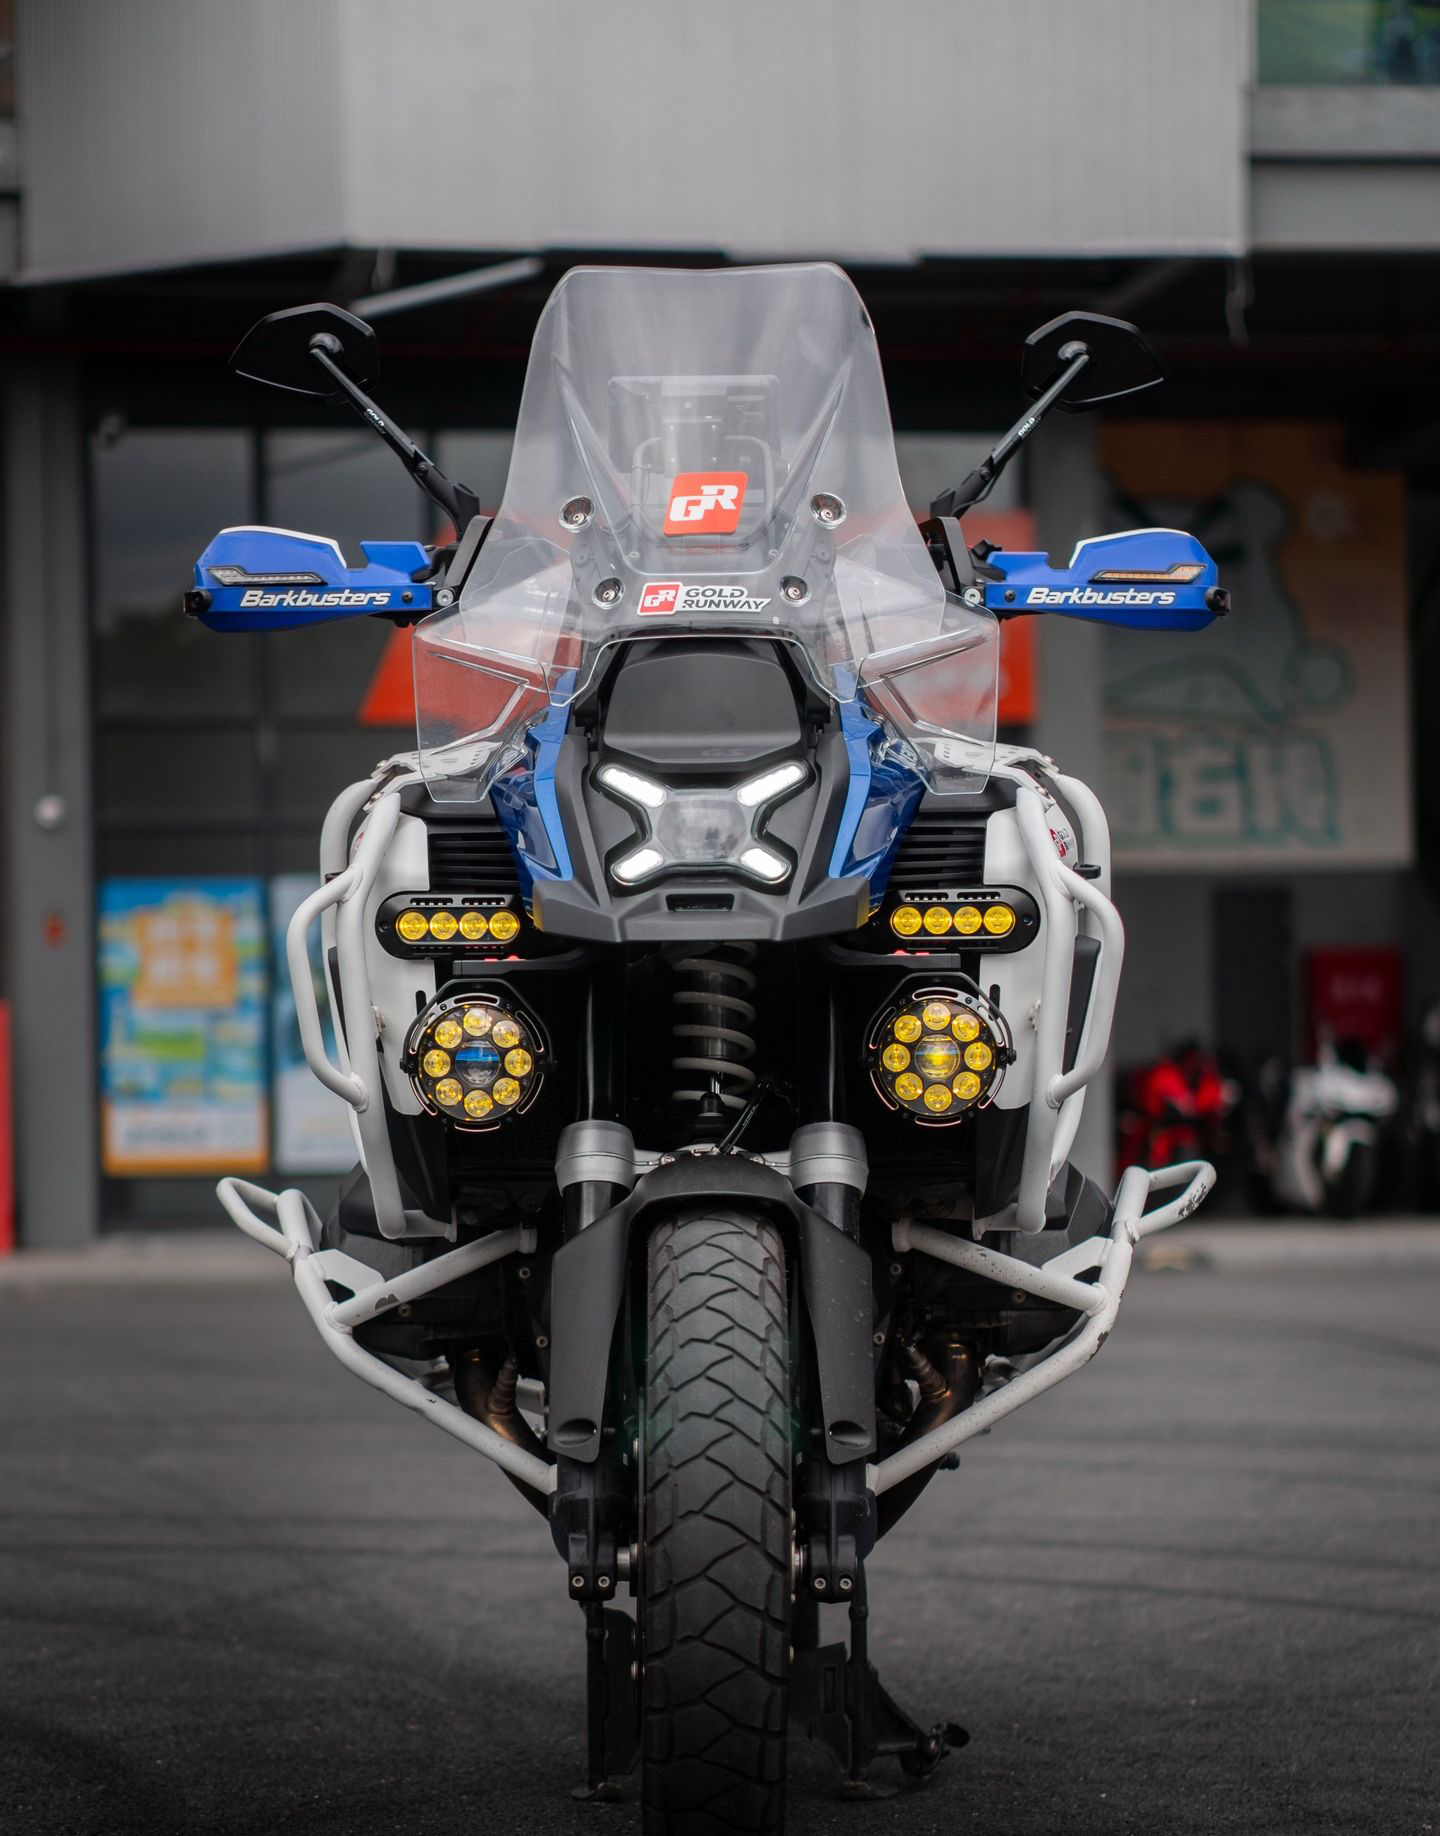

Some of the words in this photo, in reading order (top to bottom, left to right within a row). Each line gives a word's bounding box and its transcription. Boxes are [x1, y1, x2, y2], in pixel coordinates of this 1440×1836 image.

[669, 484, 739, 522] GR
[240, 588, 391, 609] Barkbusters
[643, 589, 676, 607] GR
[685, 587, 745, 598] GOLD
[1026, 587, 1176, 606] Barkbusters
[682, 599, 765, 609] RUNWAY
